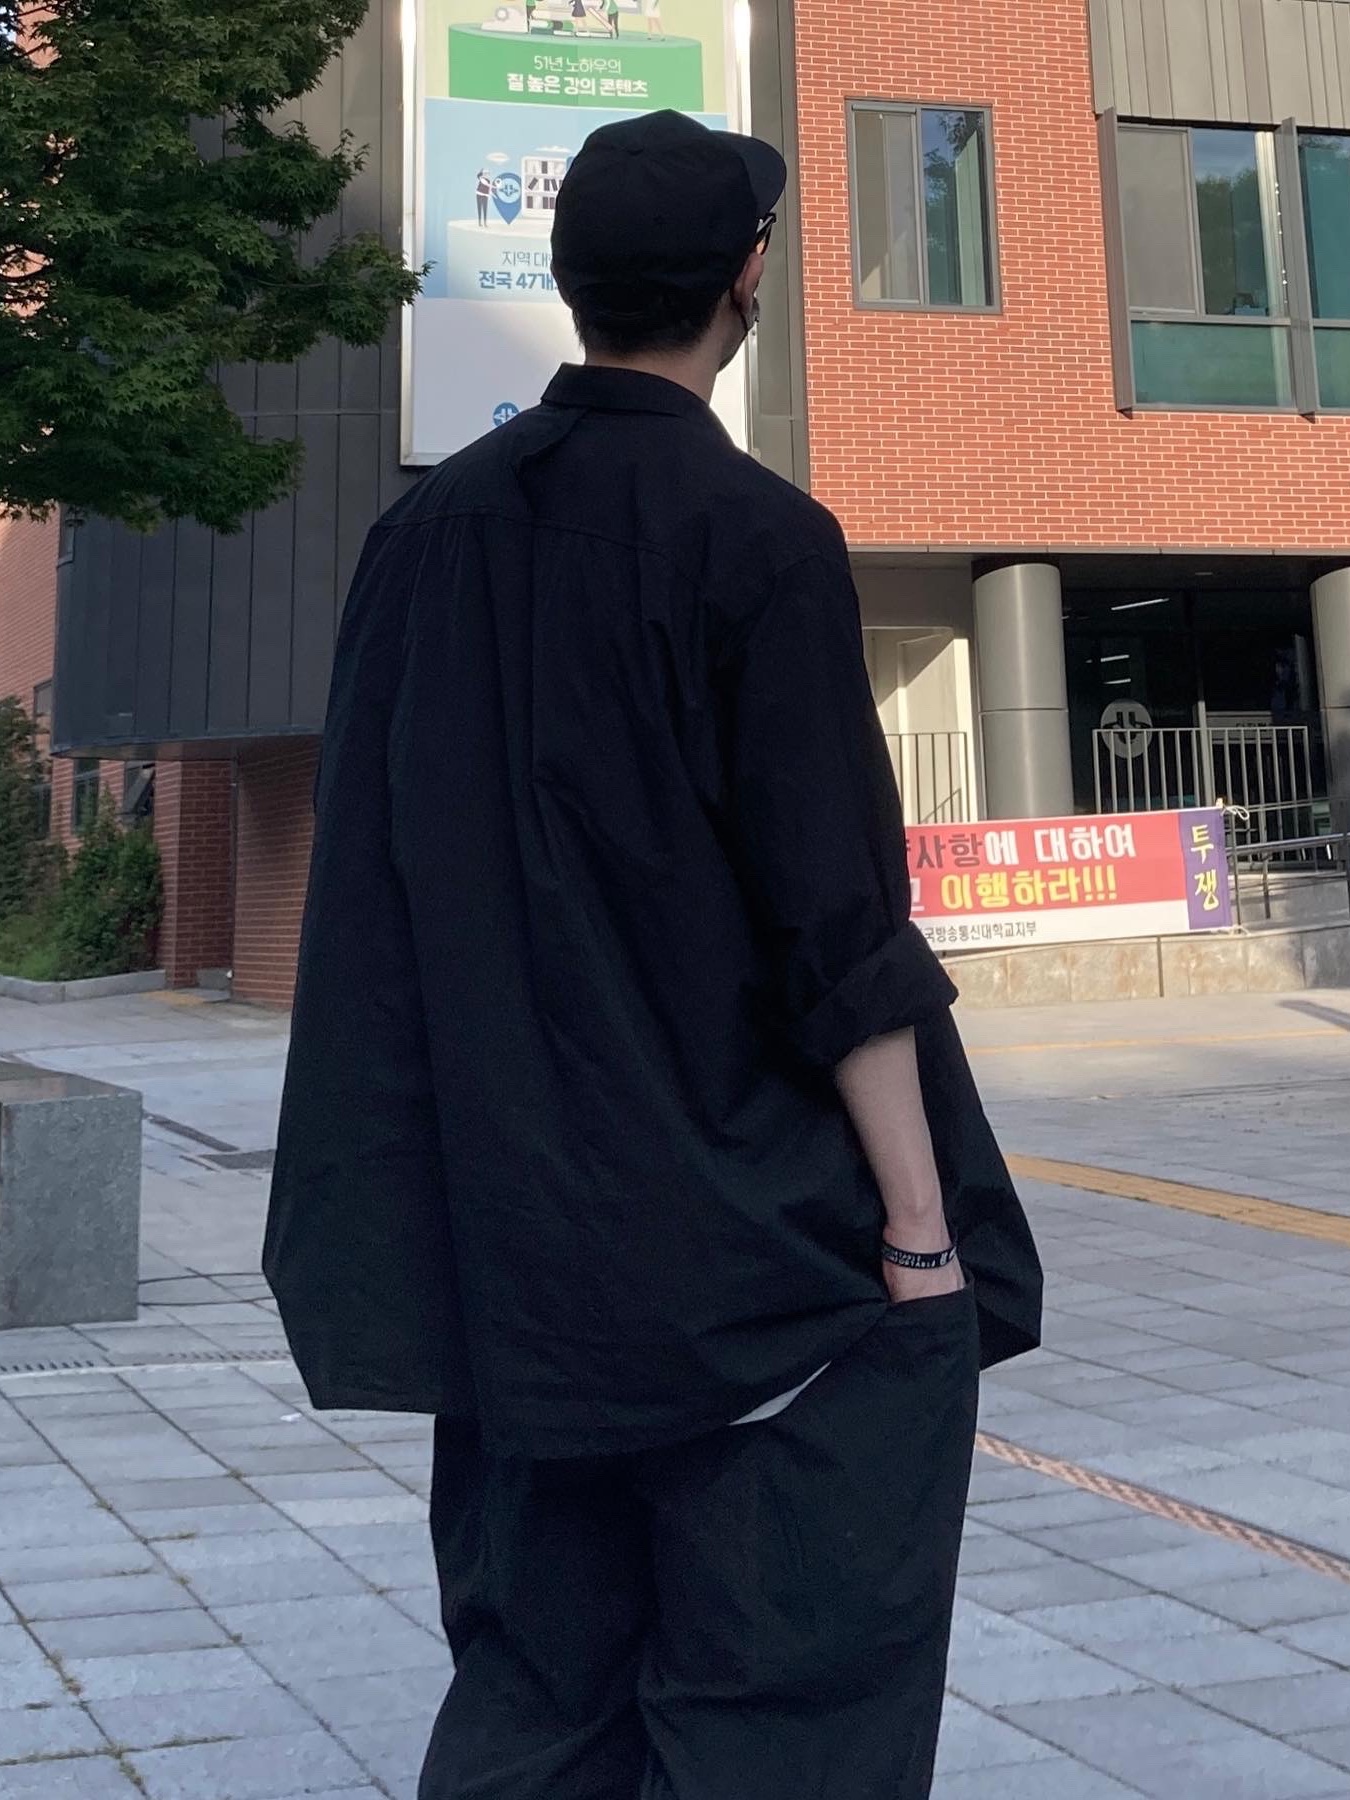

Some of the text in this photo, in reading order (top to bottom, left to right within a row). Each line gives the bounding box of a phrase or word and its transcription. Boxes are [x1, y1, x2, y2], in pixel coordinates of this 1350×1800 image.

[534, 55, 622, 74] 51년 노하우의
[507, 73, 649, 98] 질 높은 강의 콘텐츠
[502, 251, 552, 268] 지역 대
[479, 270, 558, 291] 전국 47개
[907, 823, 1136, 869] 사항에 대하여
[1190, 823, 1220, 911] 투쟁
[941, 864, 1118, 910] 이행하라!!!
[922, 921, 1037, 944] 국방송통신대학교지부
